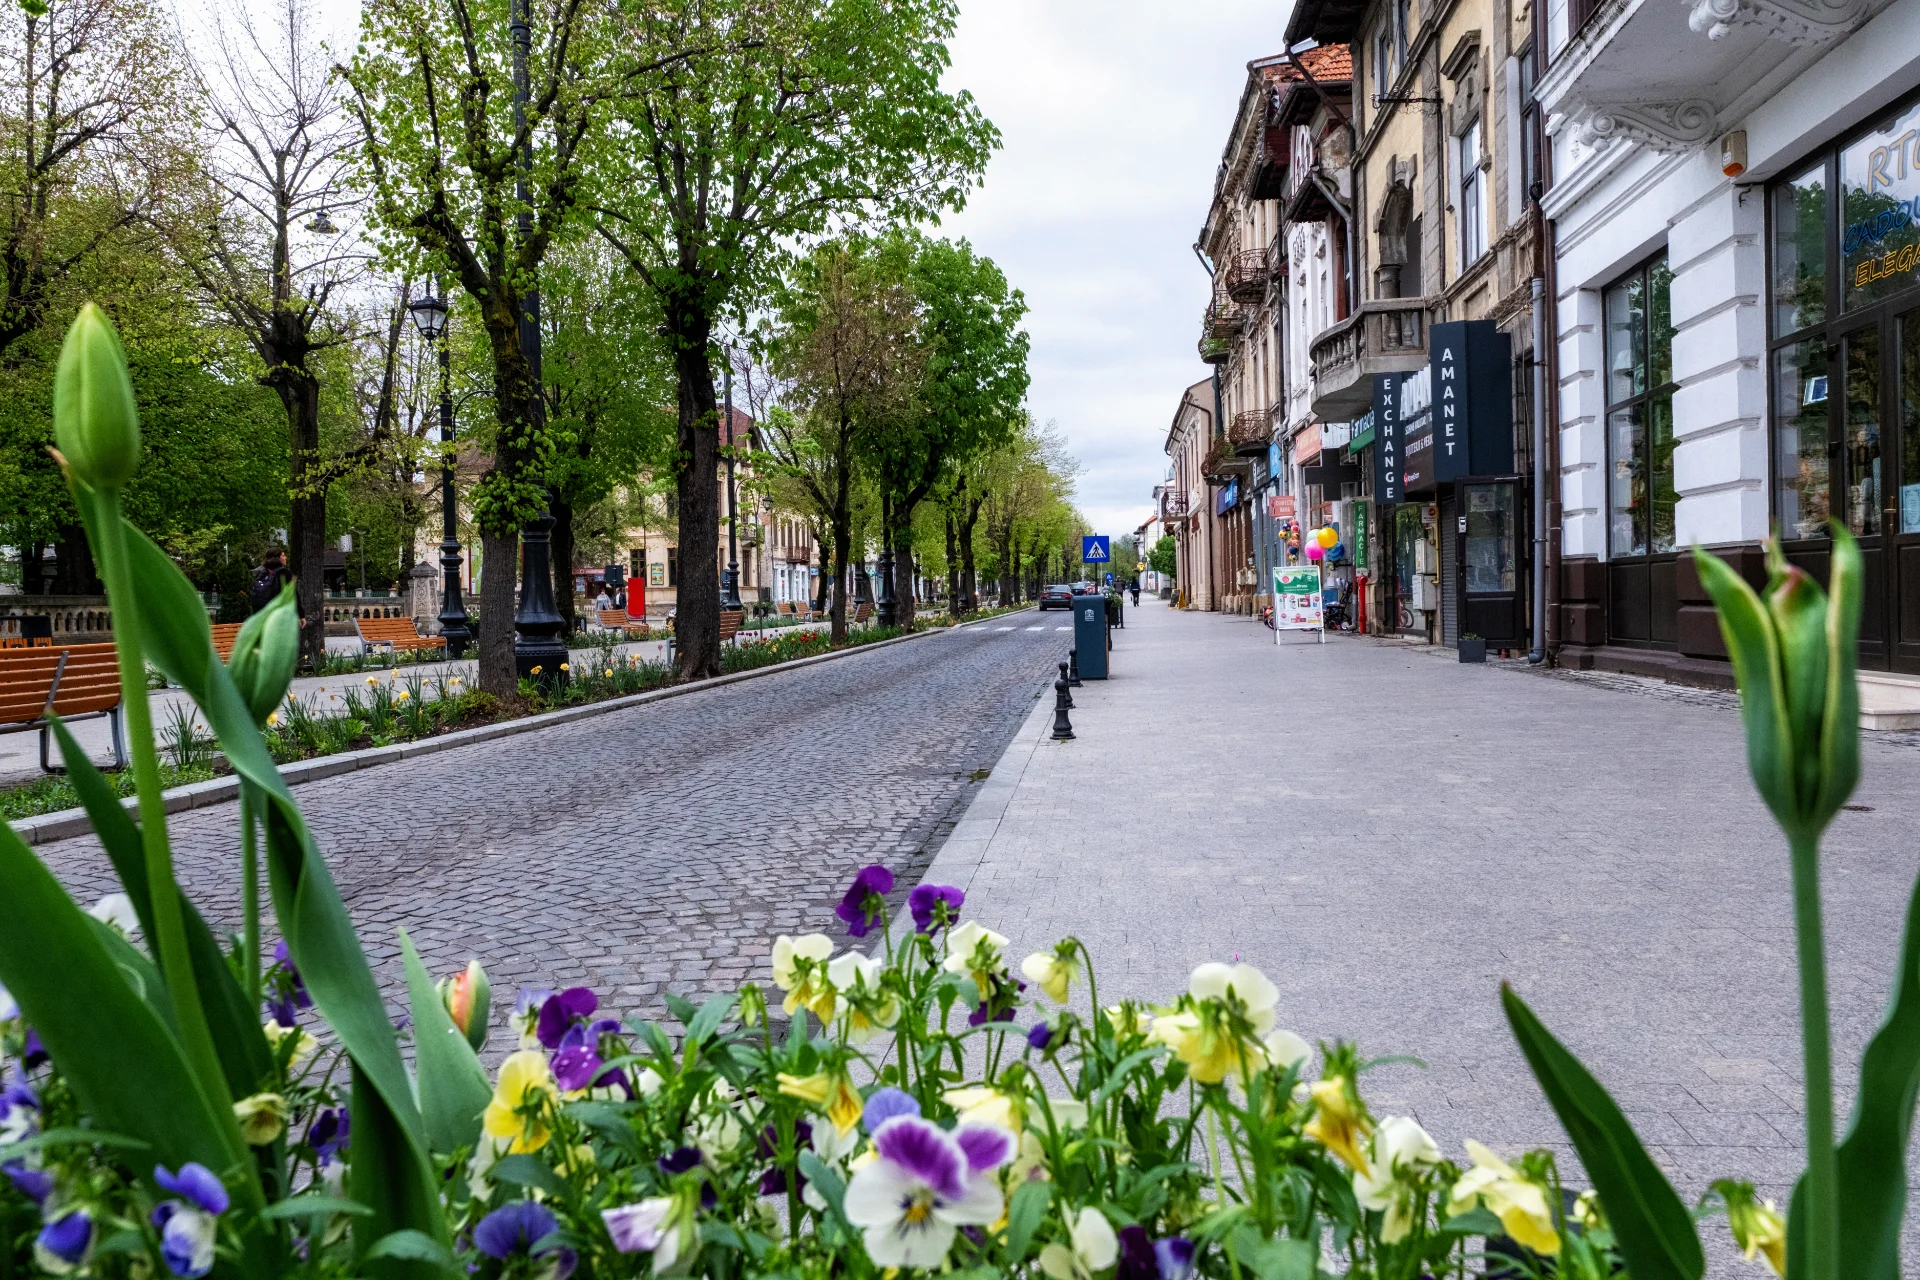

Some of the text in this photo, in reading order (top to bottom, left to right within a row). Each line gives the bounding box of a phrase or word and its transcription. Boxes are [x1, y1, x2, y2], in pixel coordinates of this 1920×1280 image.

[1383, 378, 1395, 499] EXCHANGE
[1441, 348, 1455, 456] AMANET
[1357, 505, 1365, 565] FARMACIE
